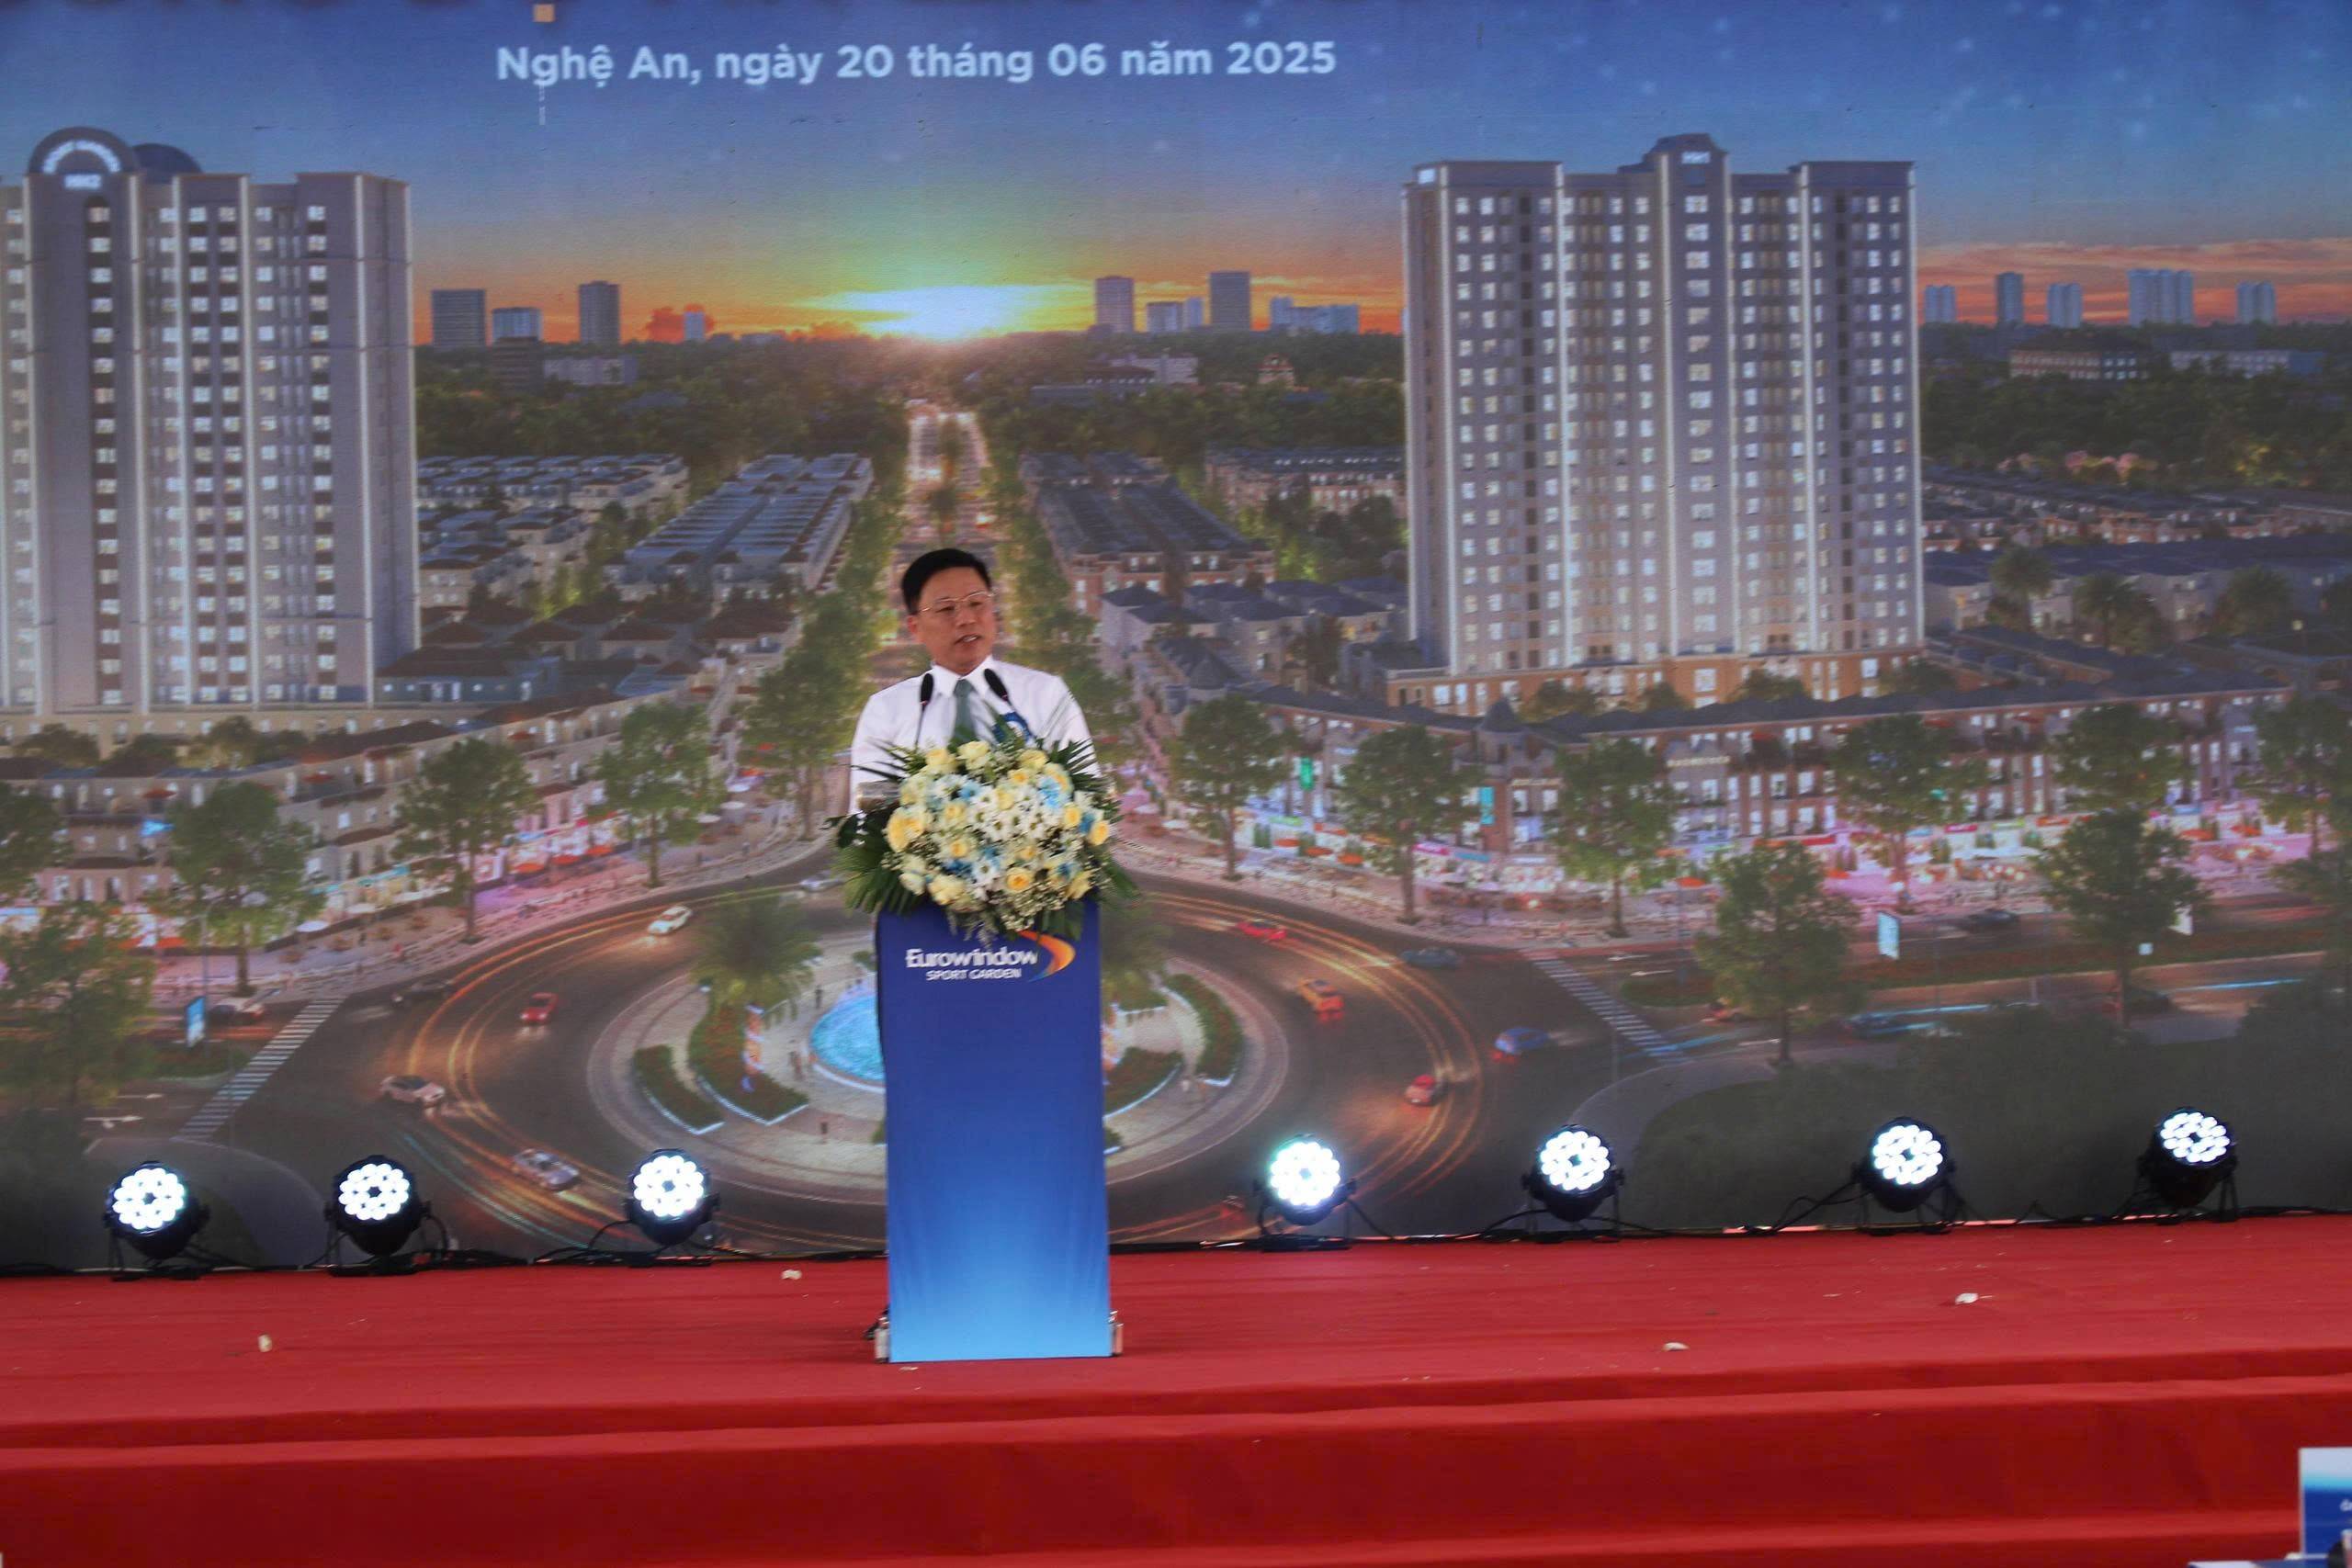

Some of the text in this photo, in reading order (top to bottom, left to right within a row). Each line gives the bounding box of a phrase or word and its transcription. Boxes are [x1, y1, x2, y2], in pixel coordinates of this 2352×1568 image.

[497, 40, 1337, 87] Nghệ An, ngày 20 tháng 06 năm 2025
[905, 946, 1038, 968] Eurowindow
[925, 968, 1022, 982] SPORT GARDEN
